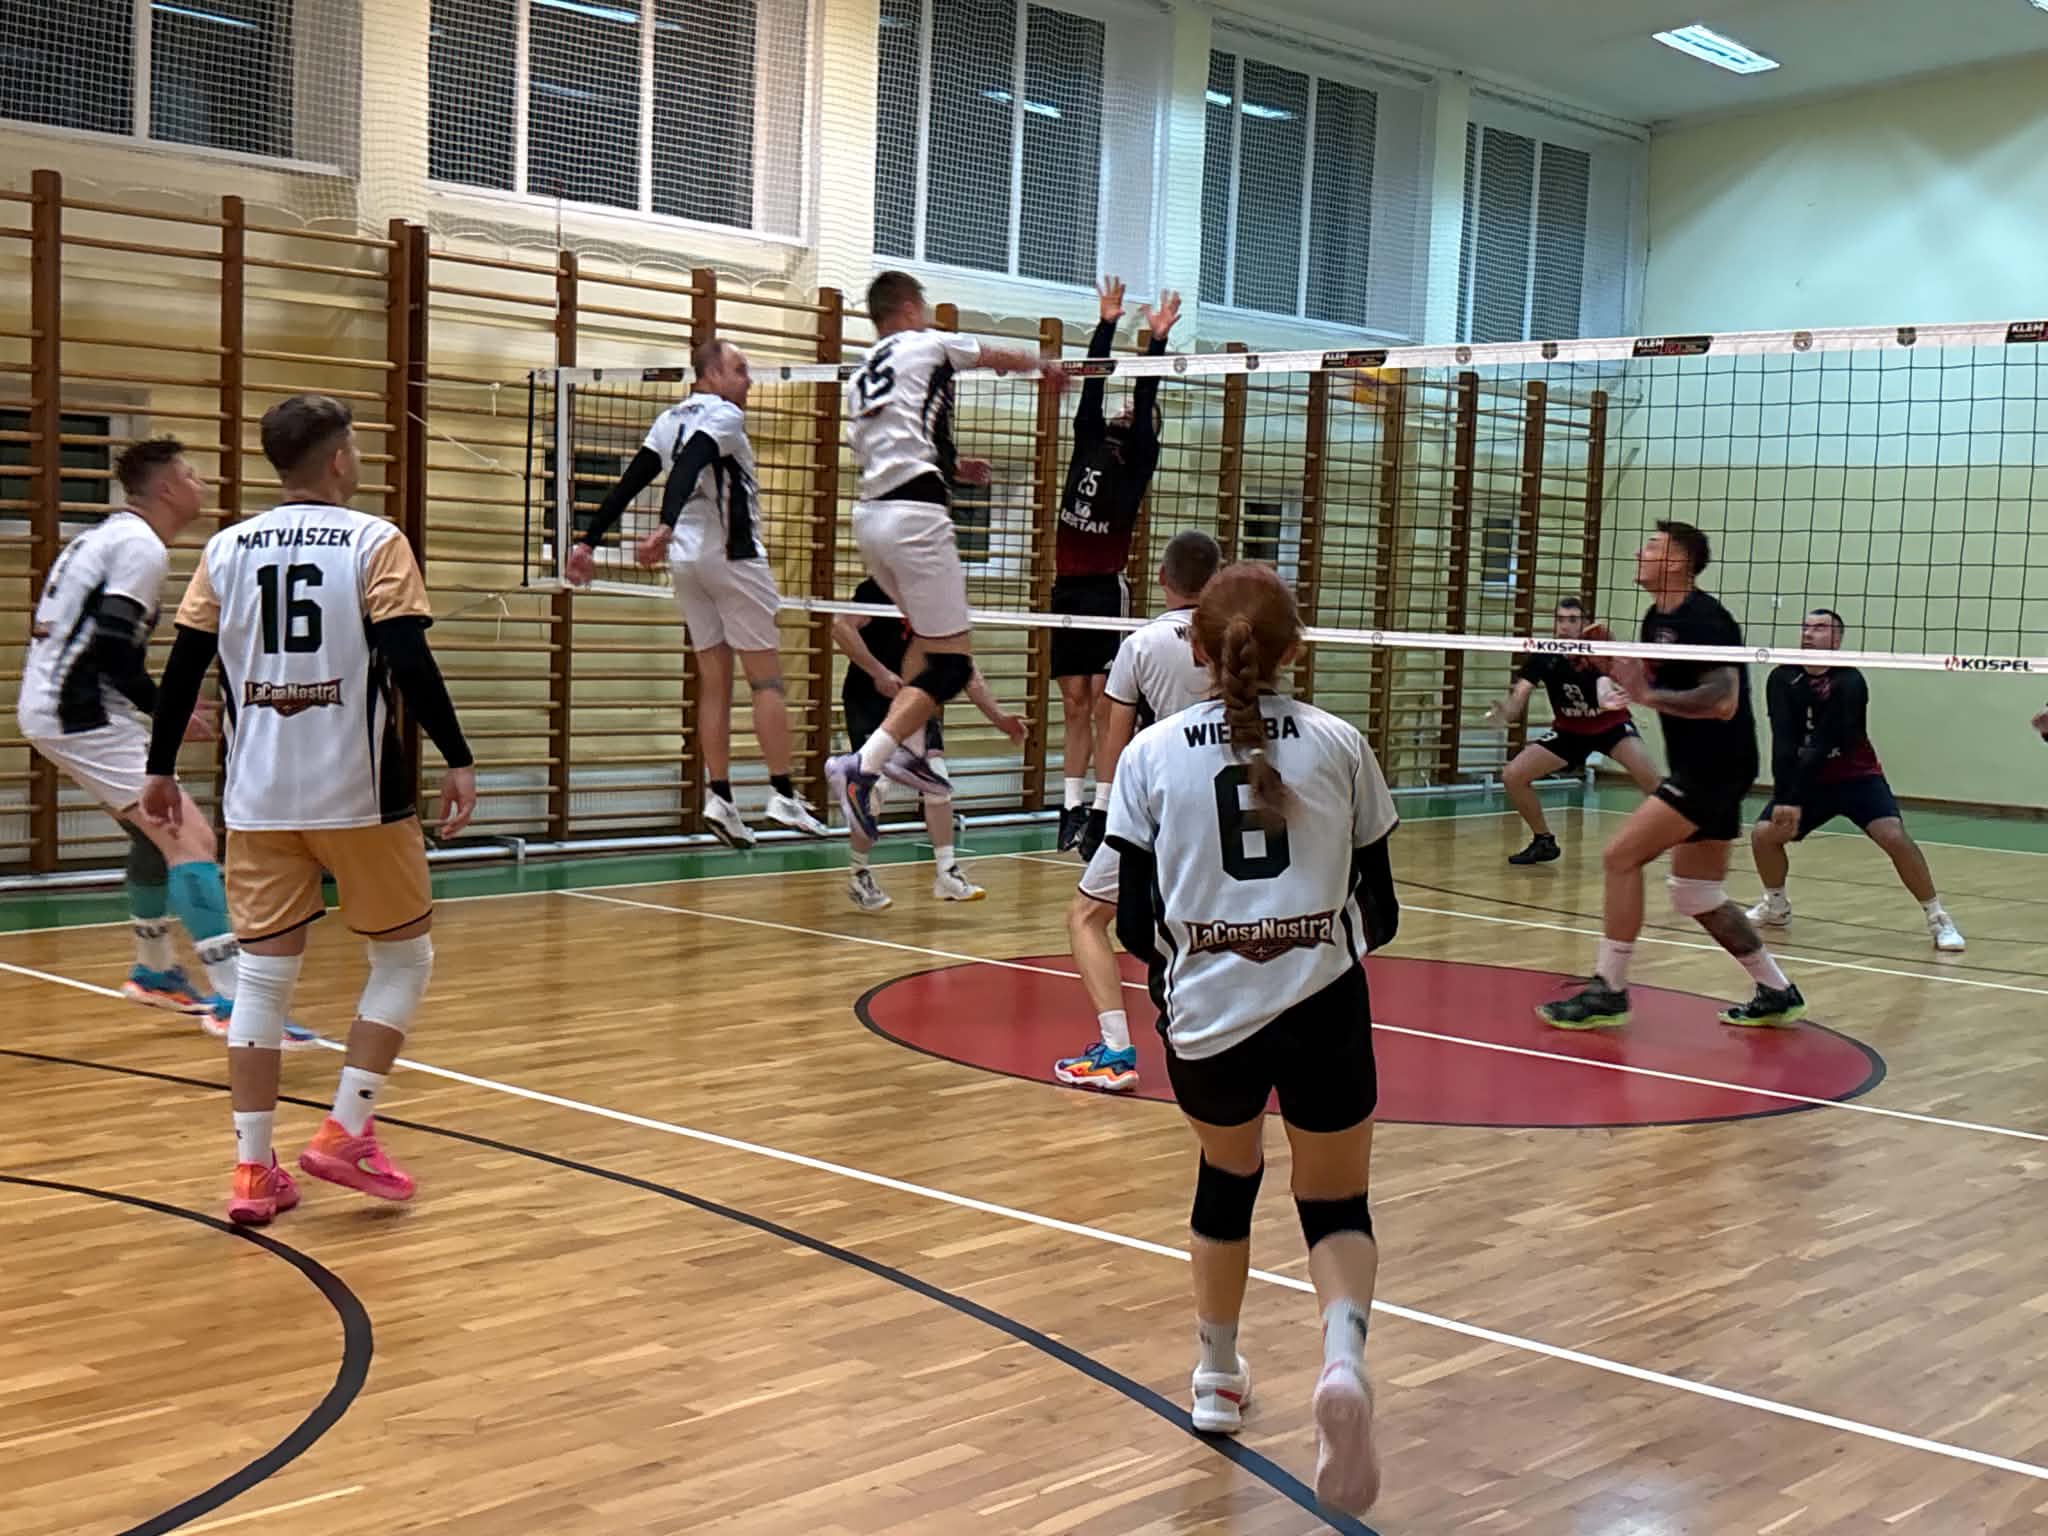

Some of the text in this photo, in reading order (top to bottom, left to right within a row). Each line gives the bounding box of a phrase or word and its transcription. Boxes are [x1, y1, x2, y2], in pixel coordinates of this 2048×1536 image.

[237, 527, 354, 549] MATYJASZEK
[257, 563, 323, 654] 16
[1537, 641, 1595, 653] KOSPEL
[1962, 658, 2033, 672] KOSPEL
[1184, 715, 1300, 748] WIEBA
[1214, 763, 1290, 881] 6
[1190, 916, 1331, 950] LaCosaNostra
